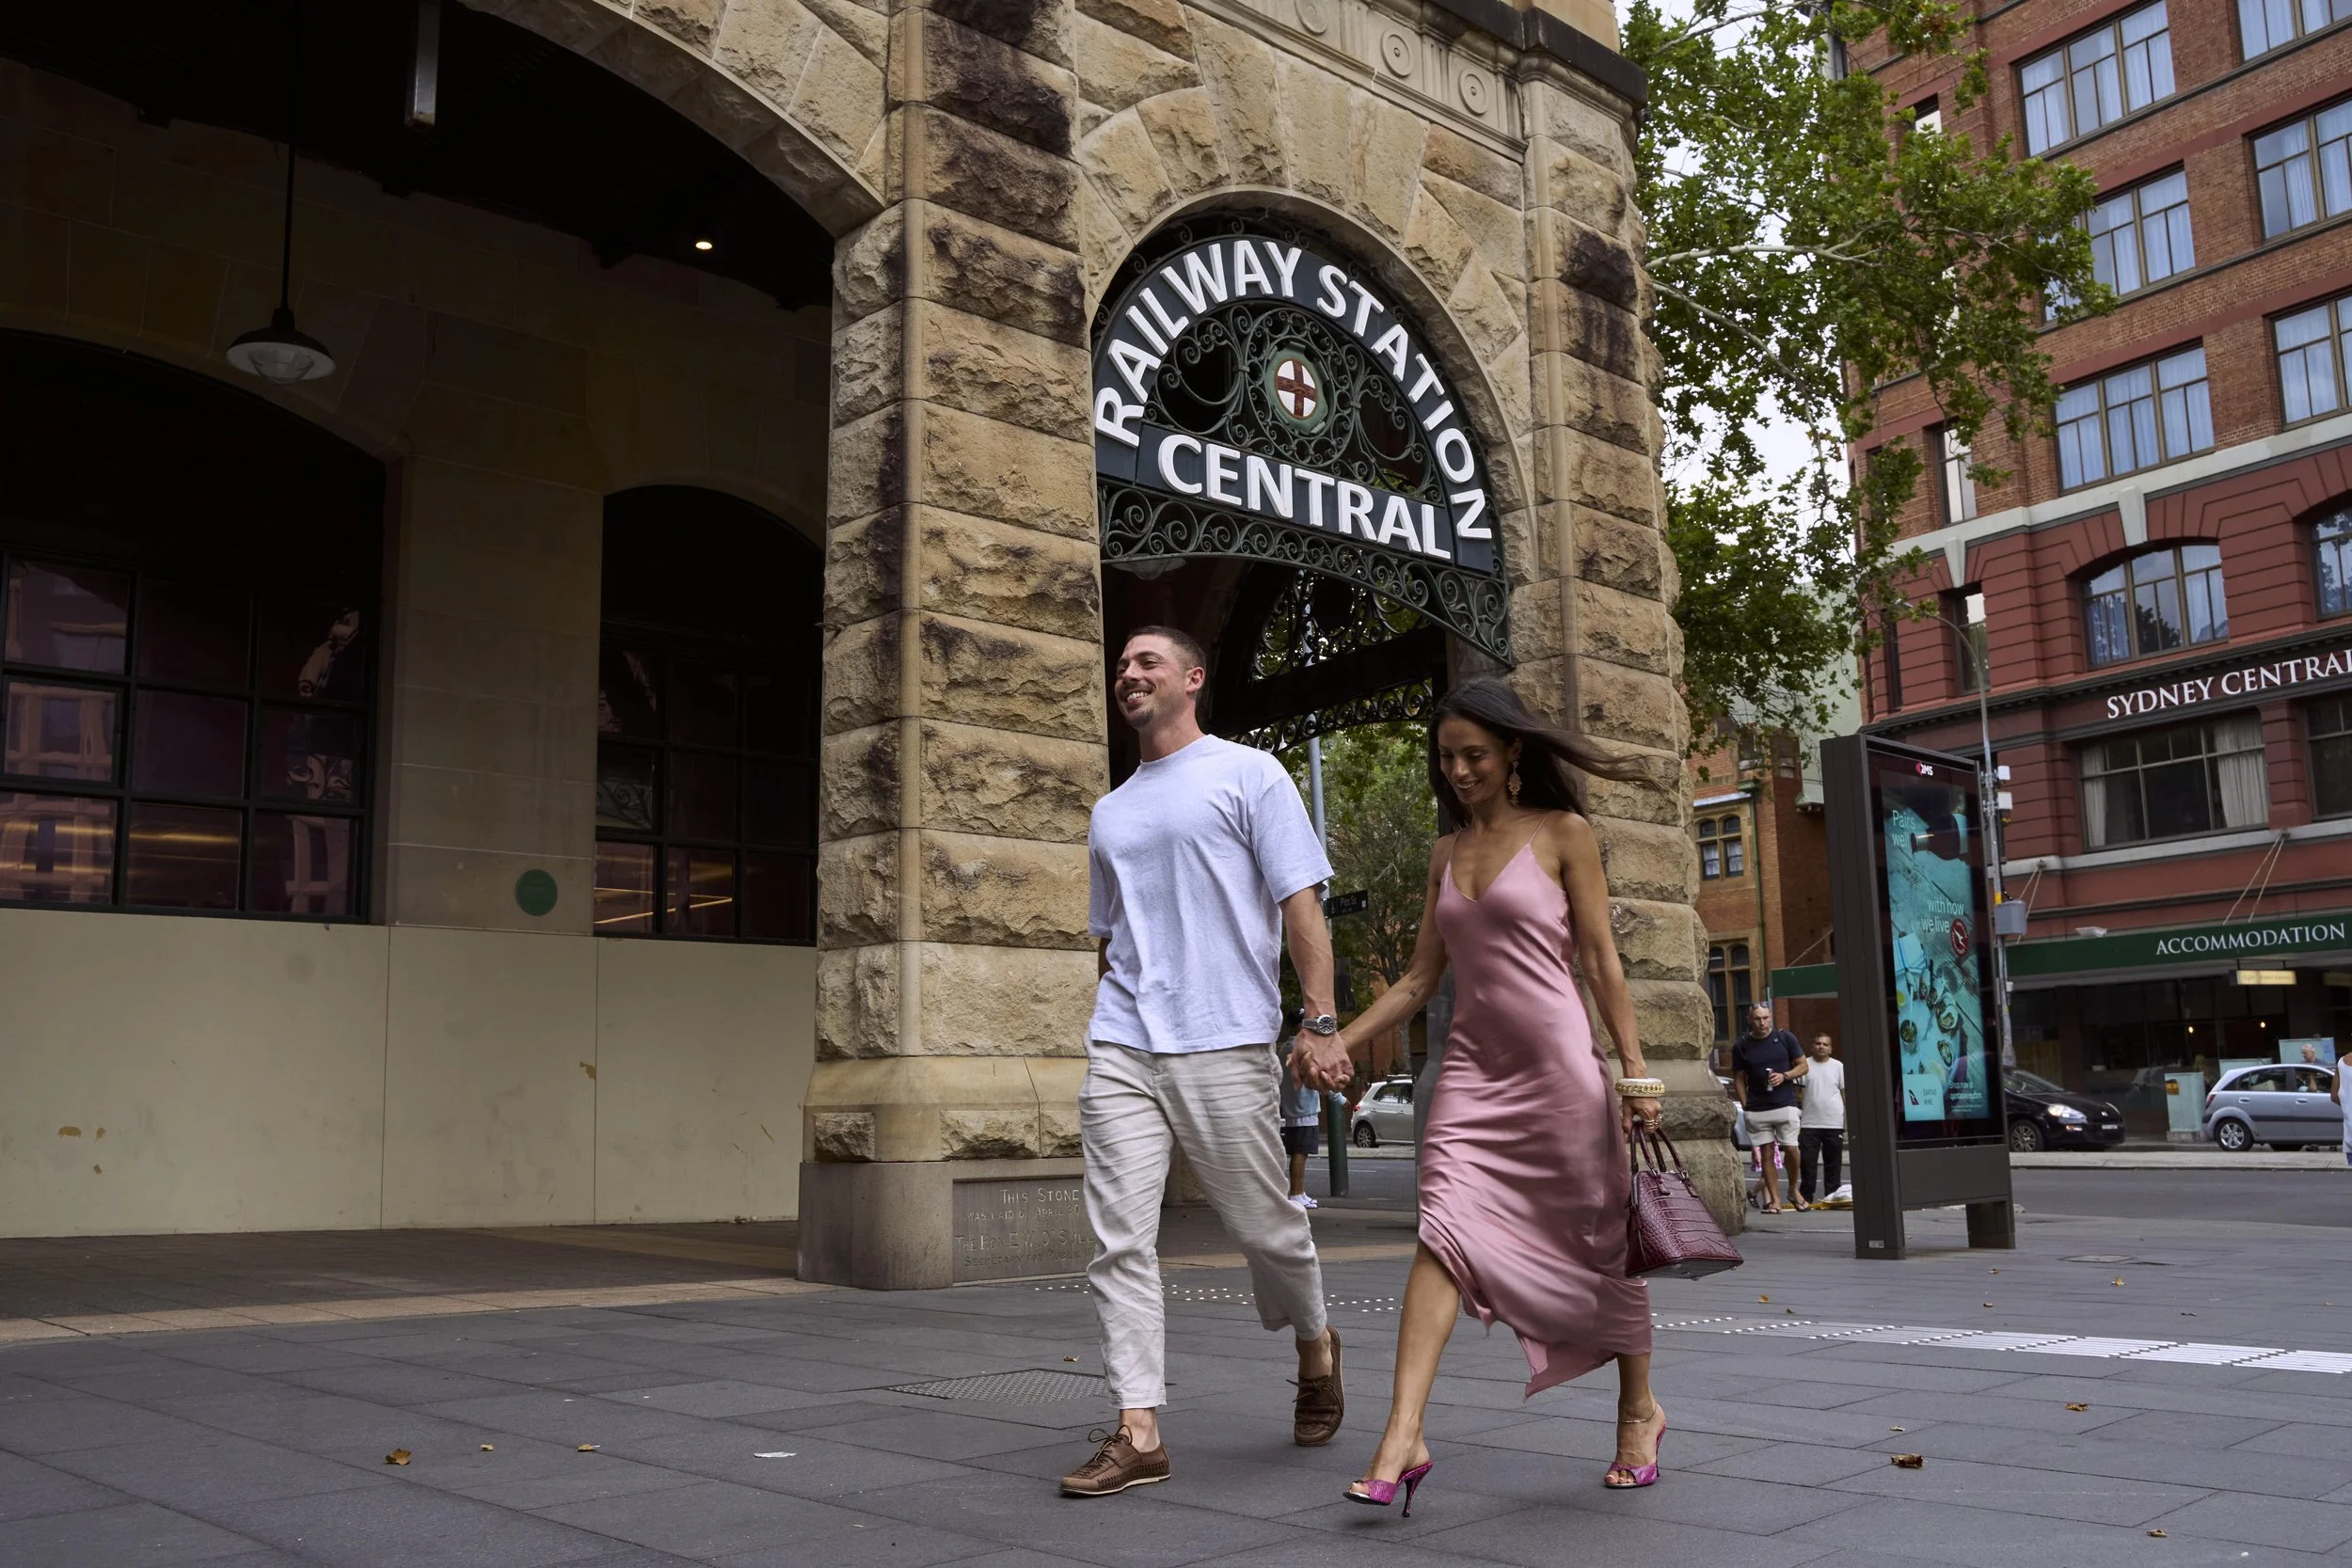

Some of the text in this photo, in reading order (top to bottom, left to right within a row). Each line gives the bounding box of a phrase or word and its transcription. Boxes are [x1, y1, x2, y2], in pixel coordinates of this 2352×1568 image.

[1094, 239, 1492, 540] RAILWAY STATION
[1157, 433, 1452, 561] CENTRAL
[2106, 676, 2215, 720] SYDNEY
[1892, 810, 1915, 830] Pairs
[1892, 832, 1909, 847] well
[1927, 897, 1964, 915] with how
[1921, 915, 1950, 934] we live
[2155, 923, 2346, 956] ACCOMMODATION
[999, 1187, 1080, 1204] THIS STONE
[966, 1211, 987, 1222] WAS
[990, 1210, 1014, 1220] LAID
[1036, 1207, 1063, 1217] APRIL
